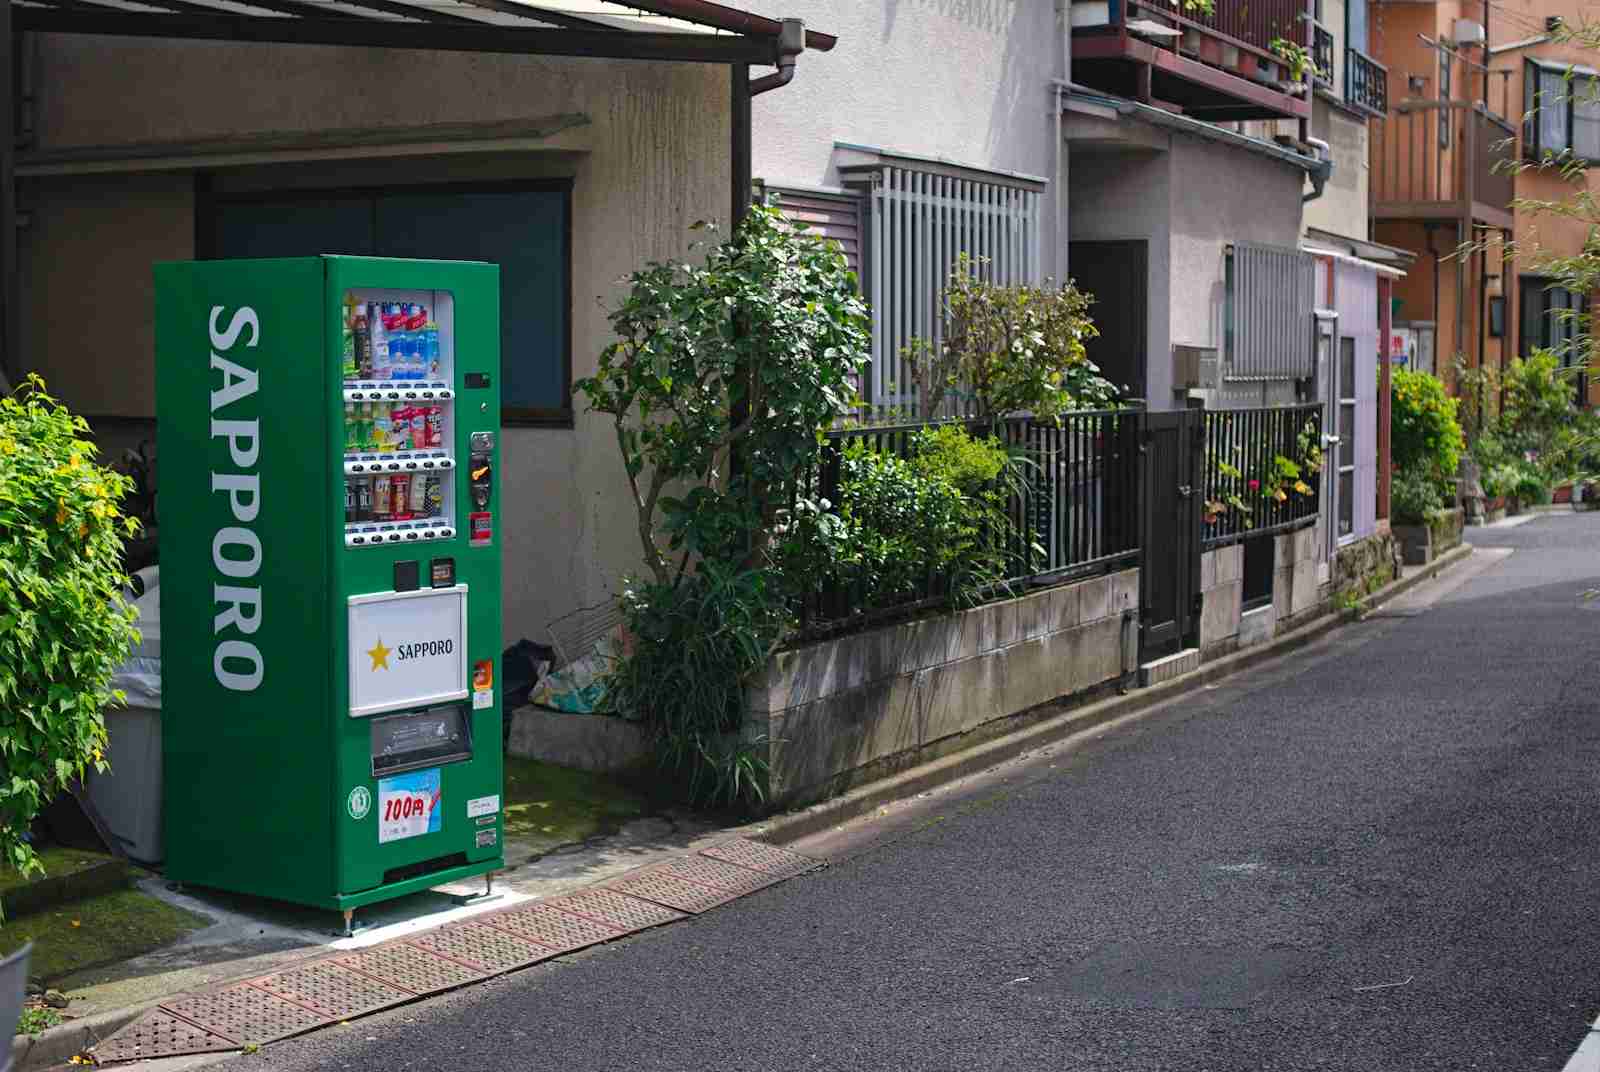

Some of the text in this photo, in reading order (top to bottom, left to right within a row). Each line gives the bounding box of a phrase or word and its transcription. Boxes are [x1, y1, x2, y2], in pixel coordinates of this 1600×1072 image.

[208, 305, 264, 692] SAPPORO
[398, 639, 453, 661] SAPPORO
[384, 796, 424, 821] 100円
